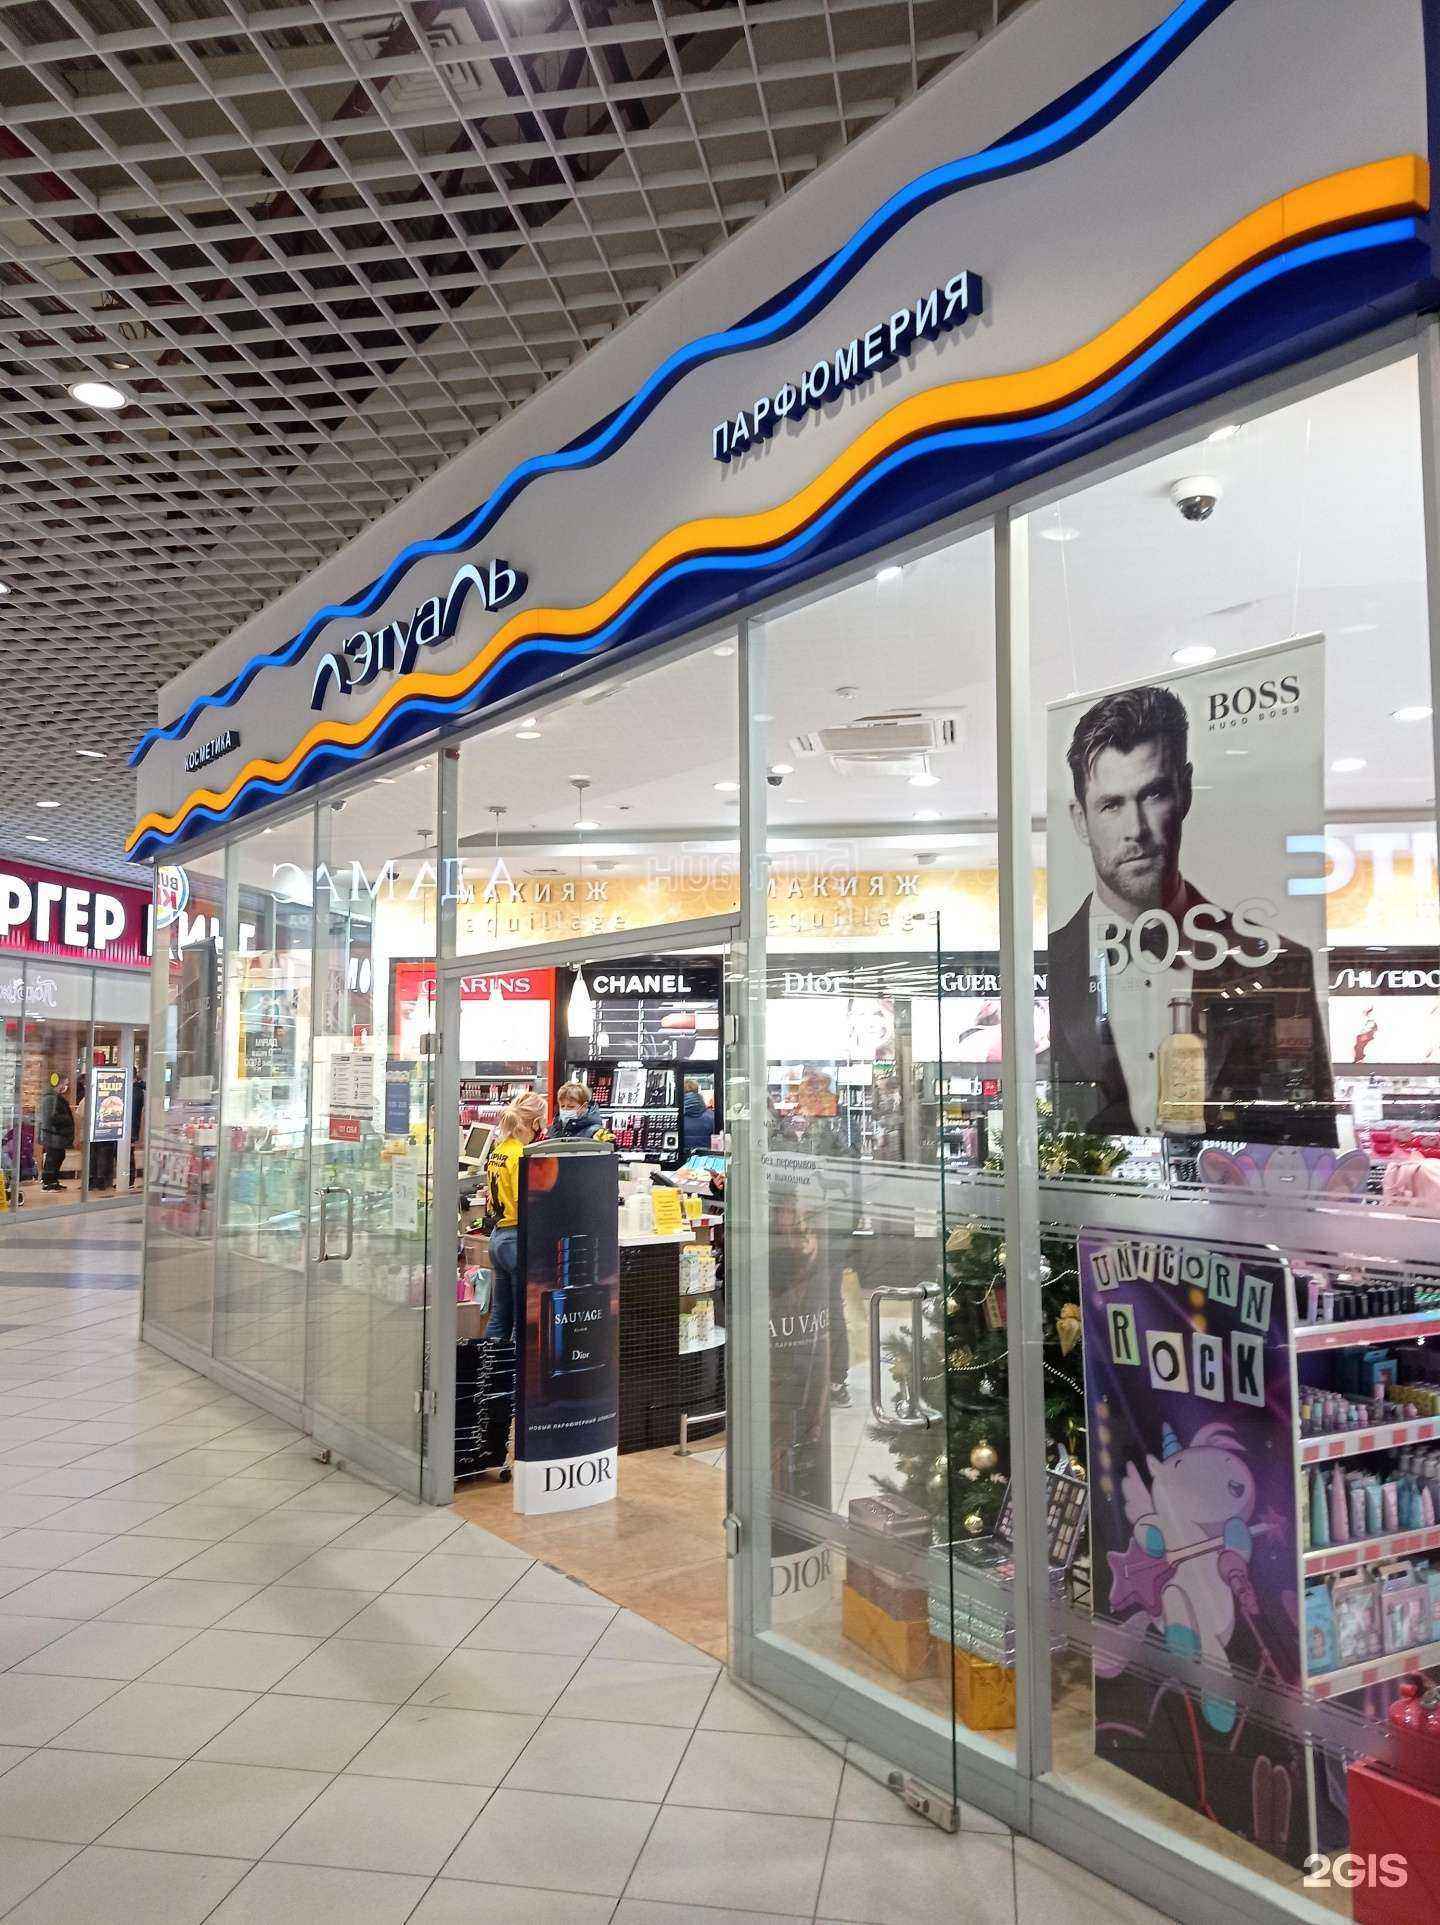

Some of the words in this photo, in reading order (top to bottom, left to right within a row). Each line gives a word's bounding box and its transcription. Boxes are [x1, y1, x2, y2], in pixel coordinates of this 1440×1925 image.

[712, 270, 983, 463] ПАРФЮМЕРИЯ
[1208, 675, 1300, 722] BOSS
[1208, 717, 1248, 732] HUGO
[1259, 705, 1300, 721] BOSS
[184, 729, 240, 773] КОСМЕТИКА
[457, 879, 609, 904] МАКИЯЖ
[1097, 897, 1281, 975] BOSS
[592, 974, 692, 994] CHANEL
[782, 972, 844, 994] Dior
[1328, 968, 1440, 989] SHISEIDO
[1093, 1247, 1267, 1325] UNICORN
[554, 1309, 602, 1325] SAUVAGE
[571, 1349, 591, 1361] Dior
[1112, 1309, 1258, 1398] ROCK
[544, 1457, 612, 1492] DIOR
[770, 1549, 831, 1597] DIOR
